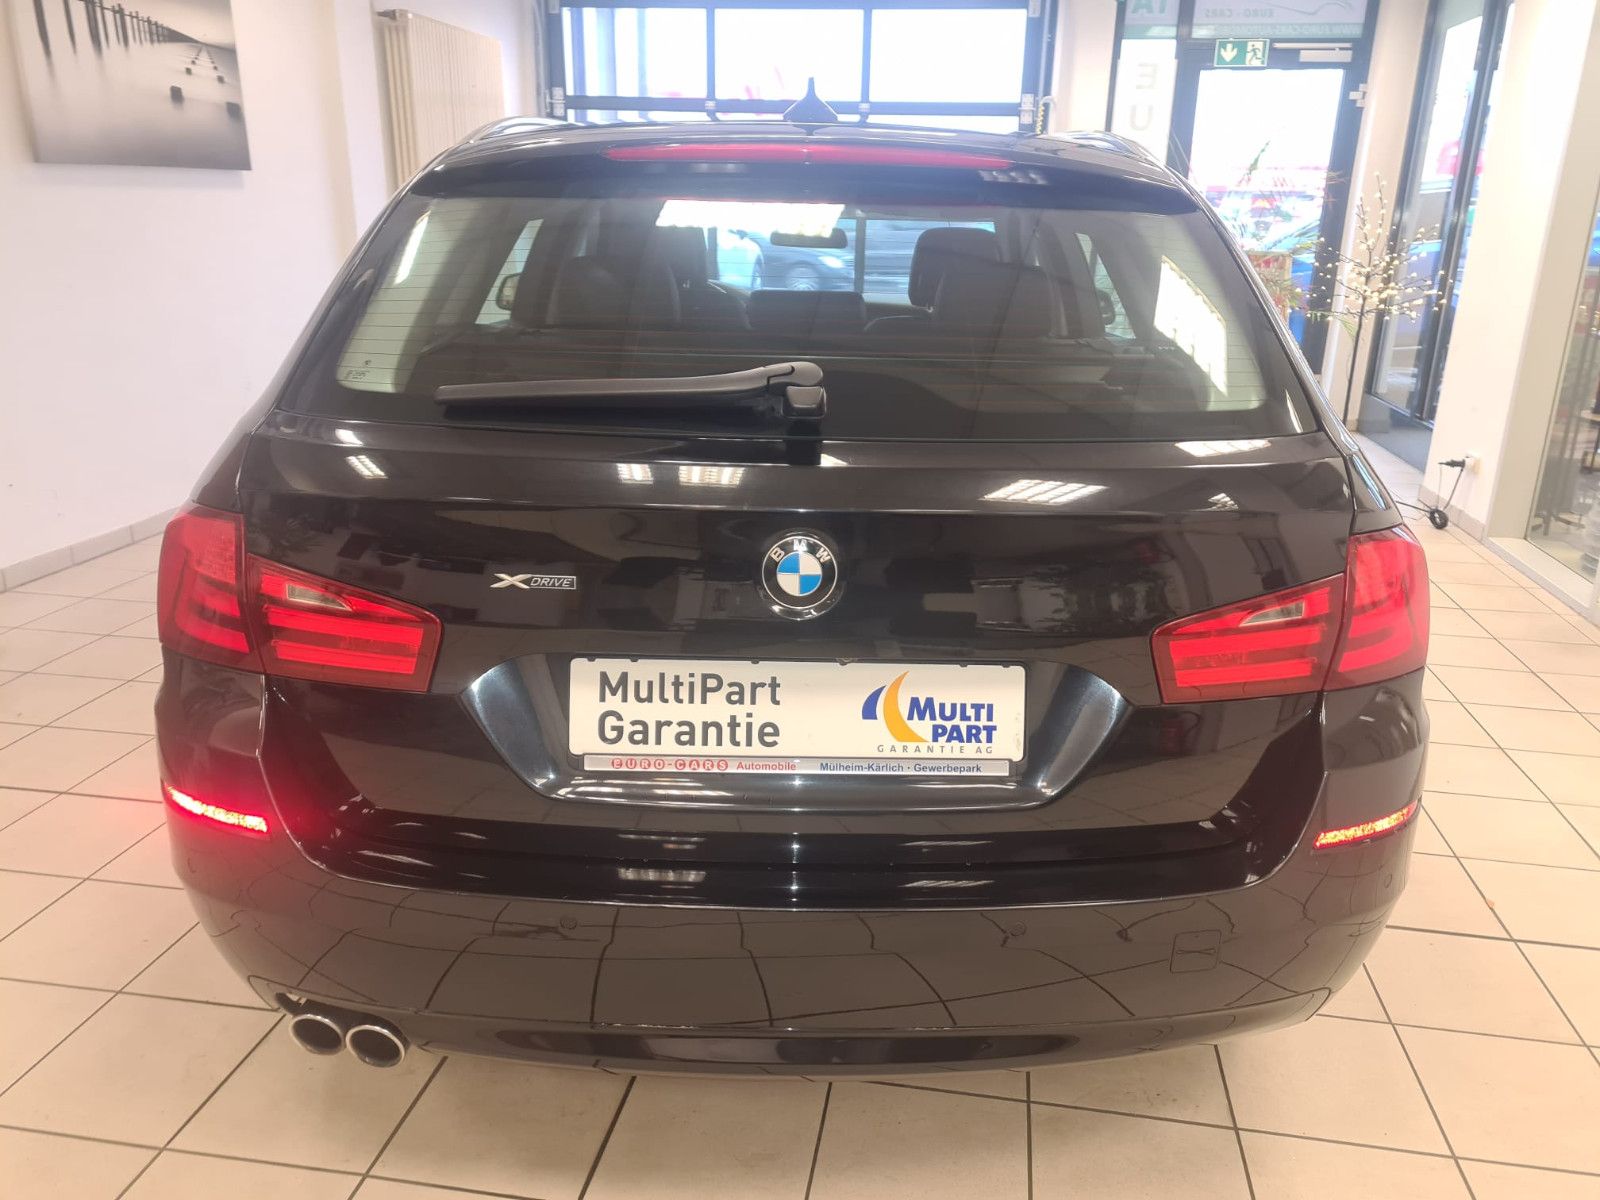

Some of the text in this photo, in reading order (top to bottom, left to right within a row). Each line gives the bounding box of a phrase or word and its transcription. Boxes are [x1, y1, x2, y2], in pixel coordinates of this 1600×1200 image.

[769, 538, 832, 563] BMW
[599, 670, 781, 706] MultiPart
[907, 696, 994, 722] MULTI
[597, 709, 780, 748] Garantie
[931, 724, 997, 744] PART
[876, 744, 993, 754] GARANTIE AG
[736, 761, 797, 771] Automobile
[819, 762, 983, 775] Mülheim-Kärlich Gewerbepark
